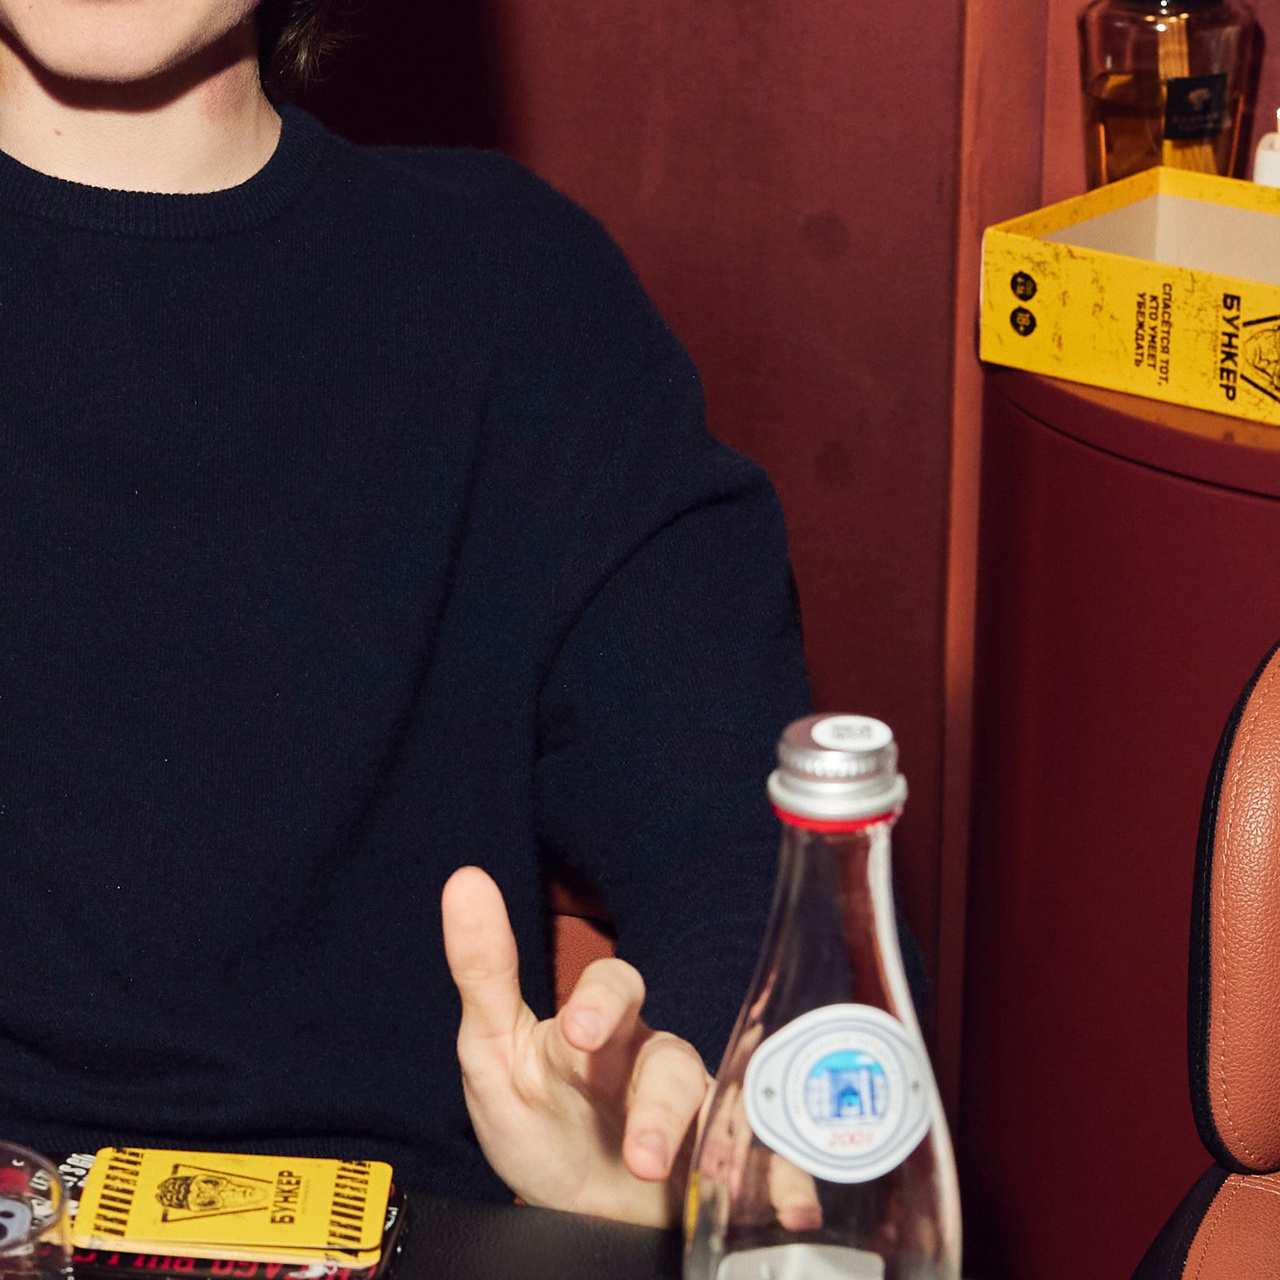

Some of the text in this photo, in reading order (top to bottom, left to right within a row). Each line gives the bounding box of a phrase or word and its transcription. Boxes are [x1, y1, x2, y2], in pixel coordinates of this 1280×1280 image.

[1134, 292, 1147, 367] УБЕЖДАТЬ
[1147, 295, 1159, 370] КТО УМЕЕТ
[1220, 293, 1241, 402] БУНКЕР
[1158, 359, 1169, 386] ТОТ,
[270, 1170, 301, 1225] БУНКЕР
